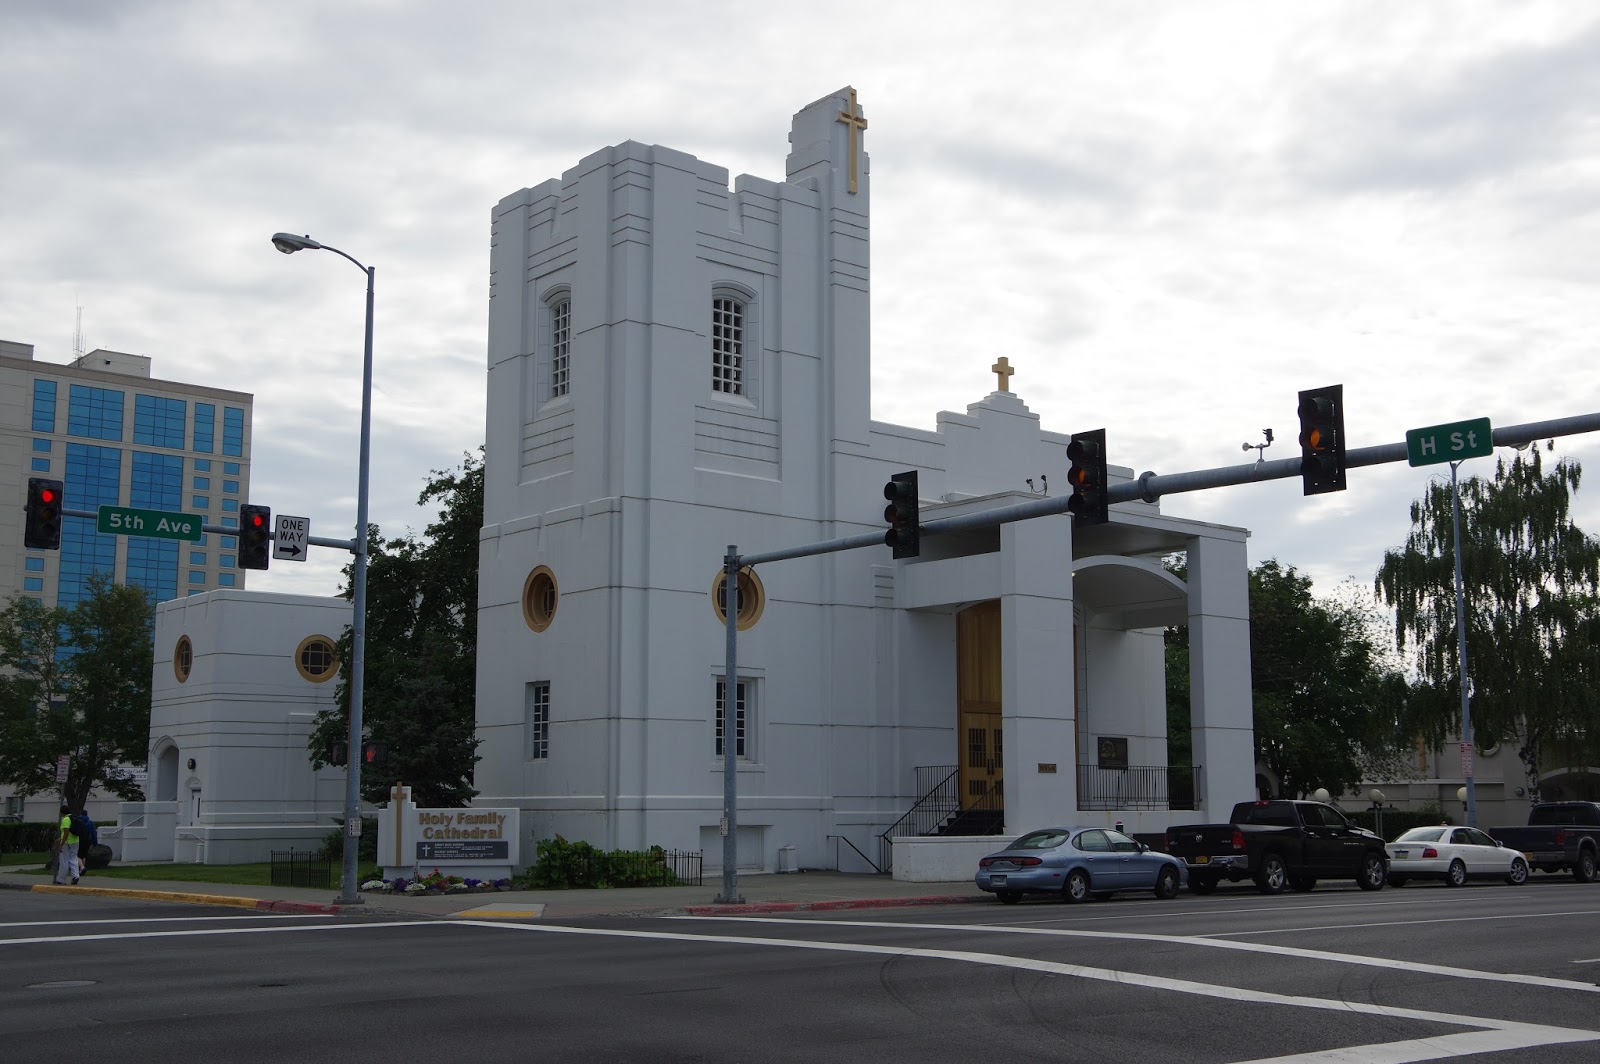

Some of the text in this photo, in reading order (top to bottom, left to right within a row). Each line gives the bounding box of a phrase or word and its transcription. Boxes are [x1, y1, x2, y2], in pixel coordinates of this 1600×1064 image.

[1420, 430, 1478, 456] H St
[109, 513, 192, 534] 5th Ave
[281, 519, 304, 531] ONE
[280, 531, 304, 542] WAY
[418, 812, 506, 827] Holy Family
[423, 825, 503, 839] Cathedral
